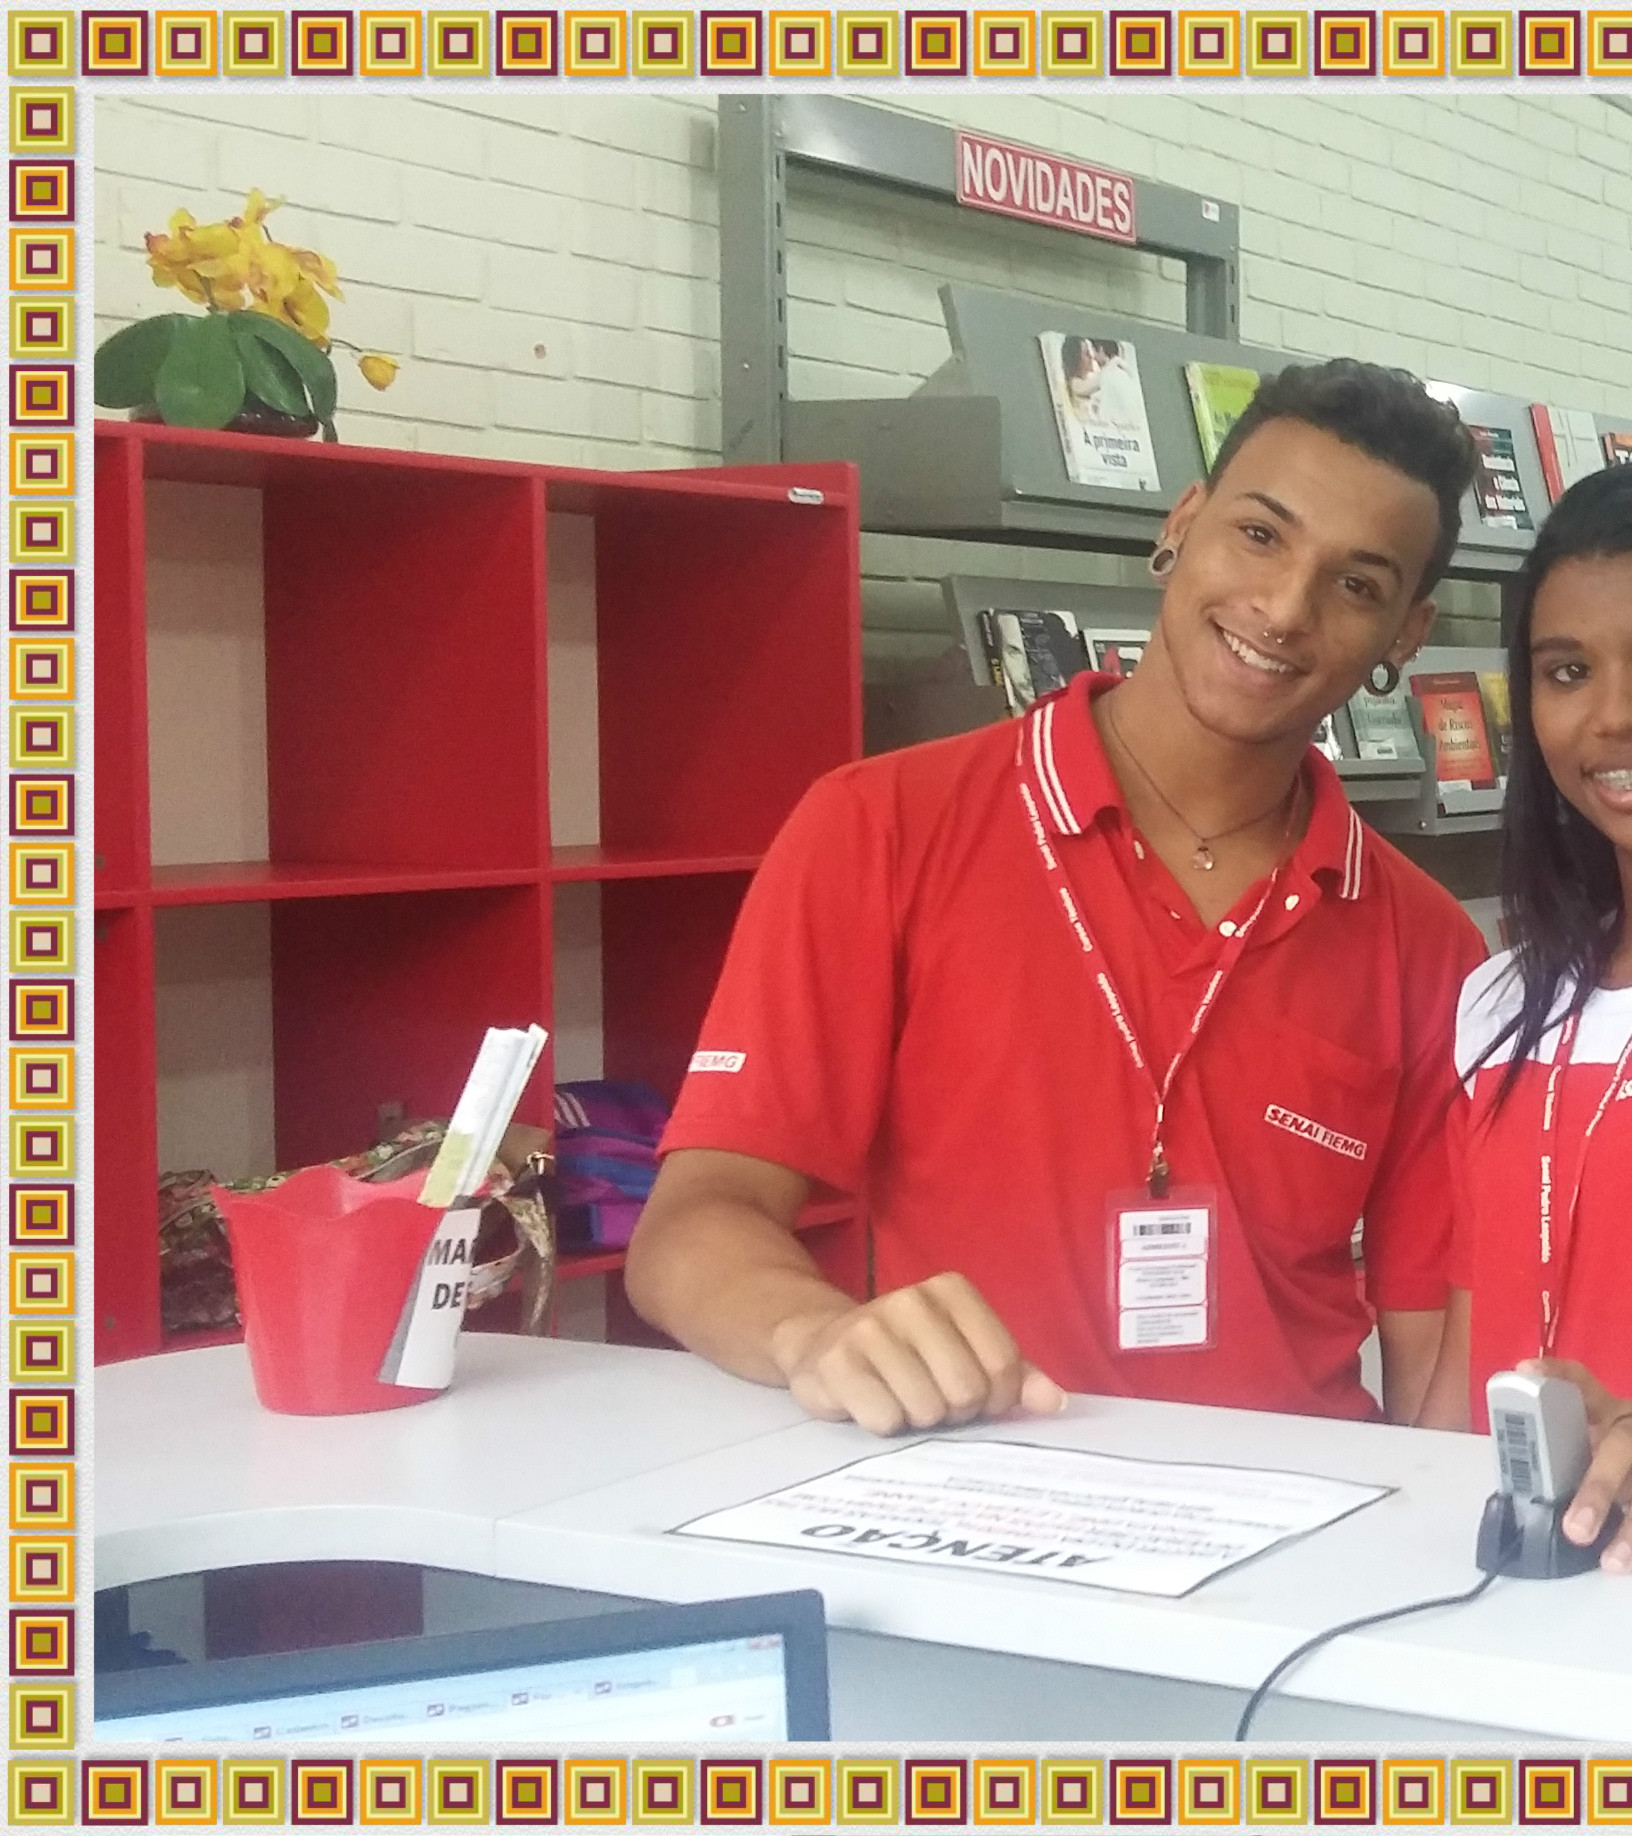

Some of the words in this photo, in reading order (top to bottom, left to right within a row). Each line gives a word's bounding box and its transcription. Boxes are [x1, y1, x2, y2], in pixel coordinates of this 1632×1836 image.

[963, 141, 1131, 234] NOVIDADES
[1093, 434, 1140, 453] primeira
[1101, 453, 1127, 467] vista
[1268, 1108, 1320, 1139] SENAI
[1321, 1130, 1365, 1157] FIEMG
